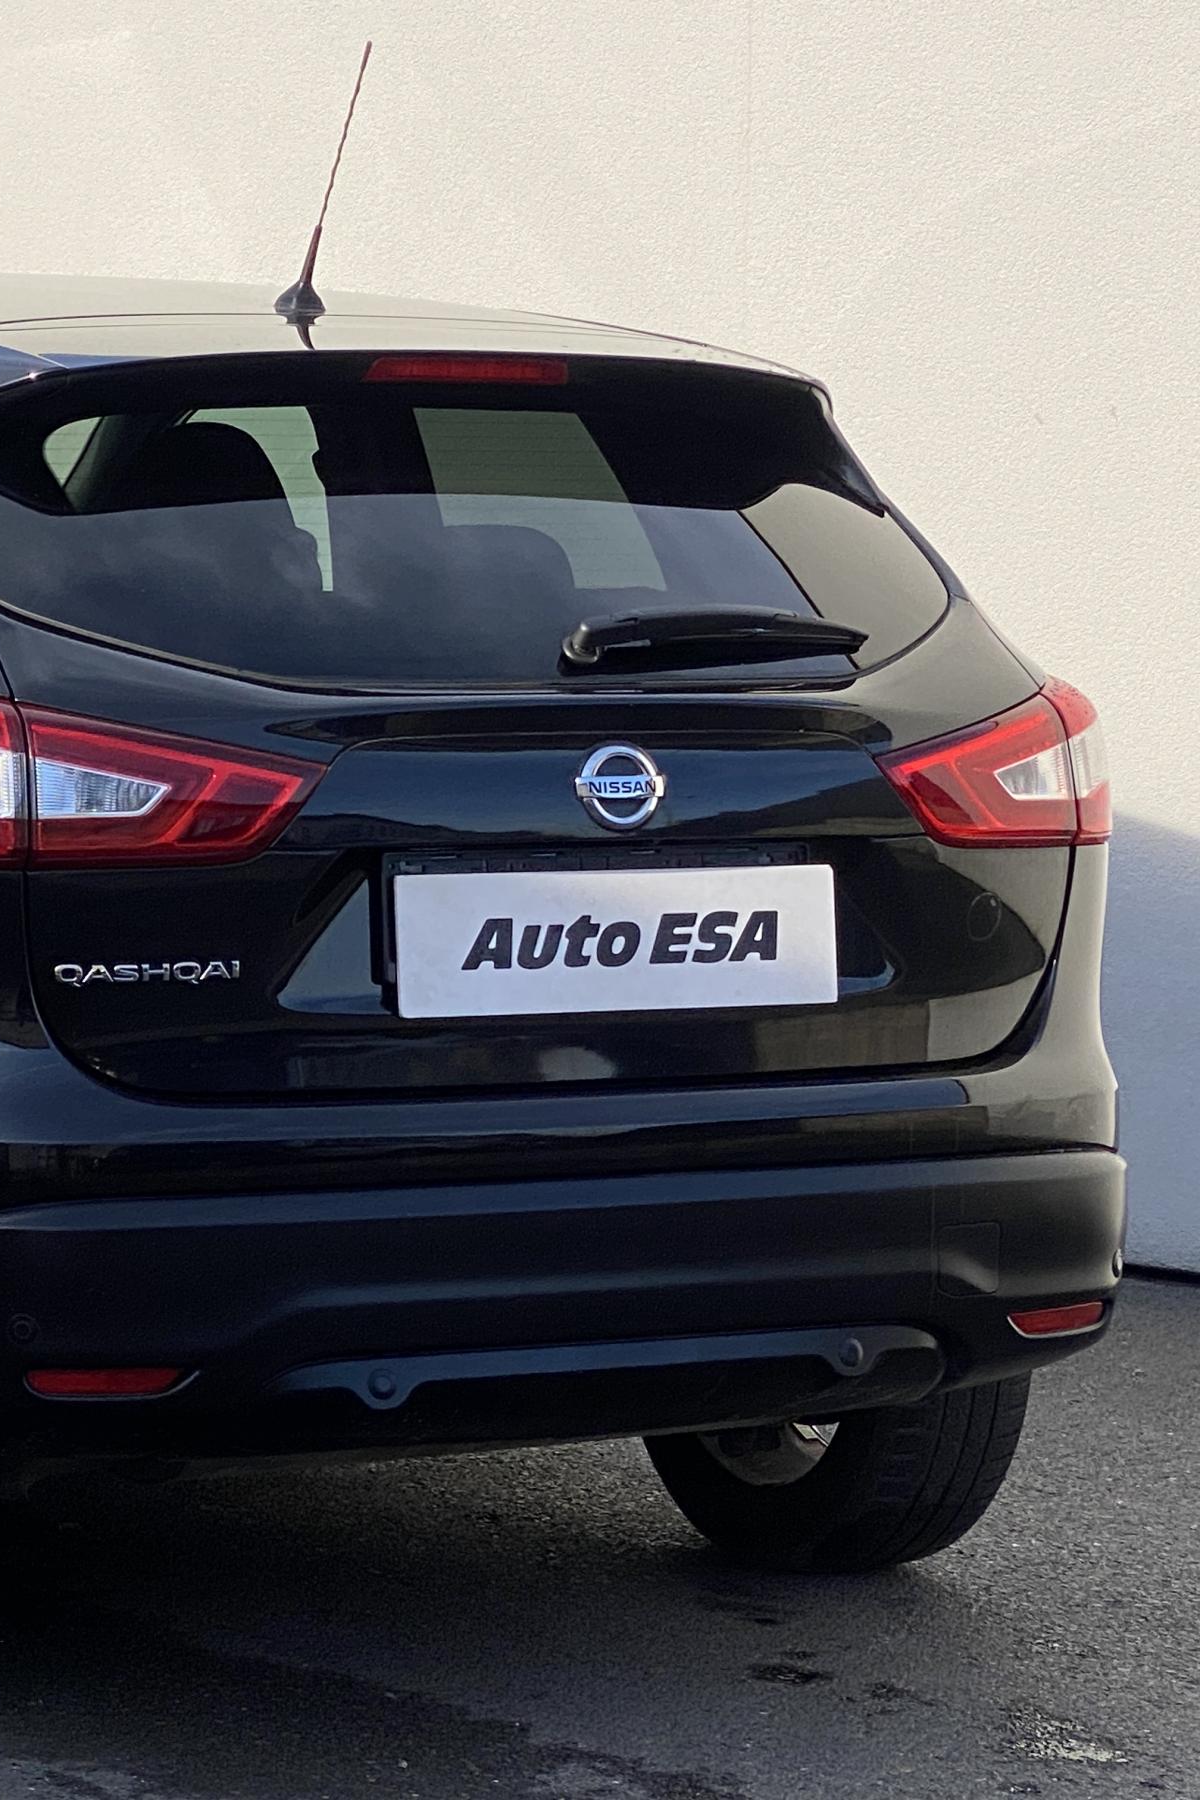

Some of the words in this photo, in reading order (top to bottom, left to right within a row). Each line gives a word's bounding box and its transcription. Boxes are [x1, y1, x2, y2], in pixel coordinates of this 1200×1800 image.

[588, 780, 656, 794] NISSAN
[461, 915, 641, 970] Auto
[649, 910, 779, 964] ESA
[53, 960, 240, 987] QASHQAI
